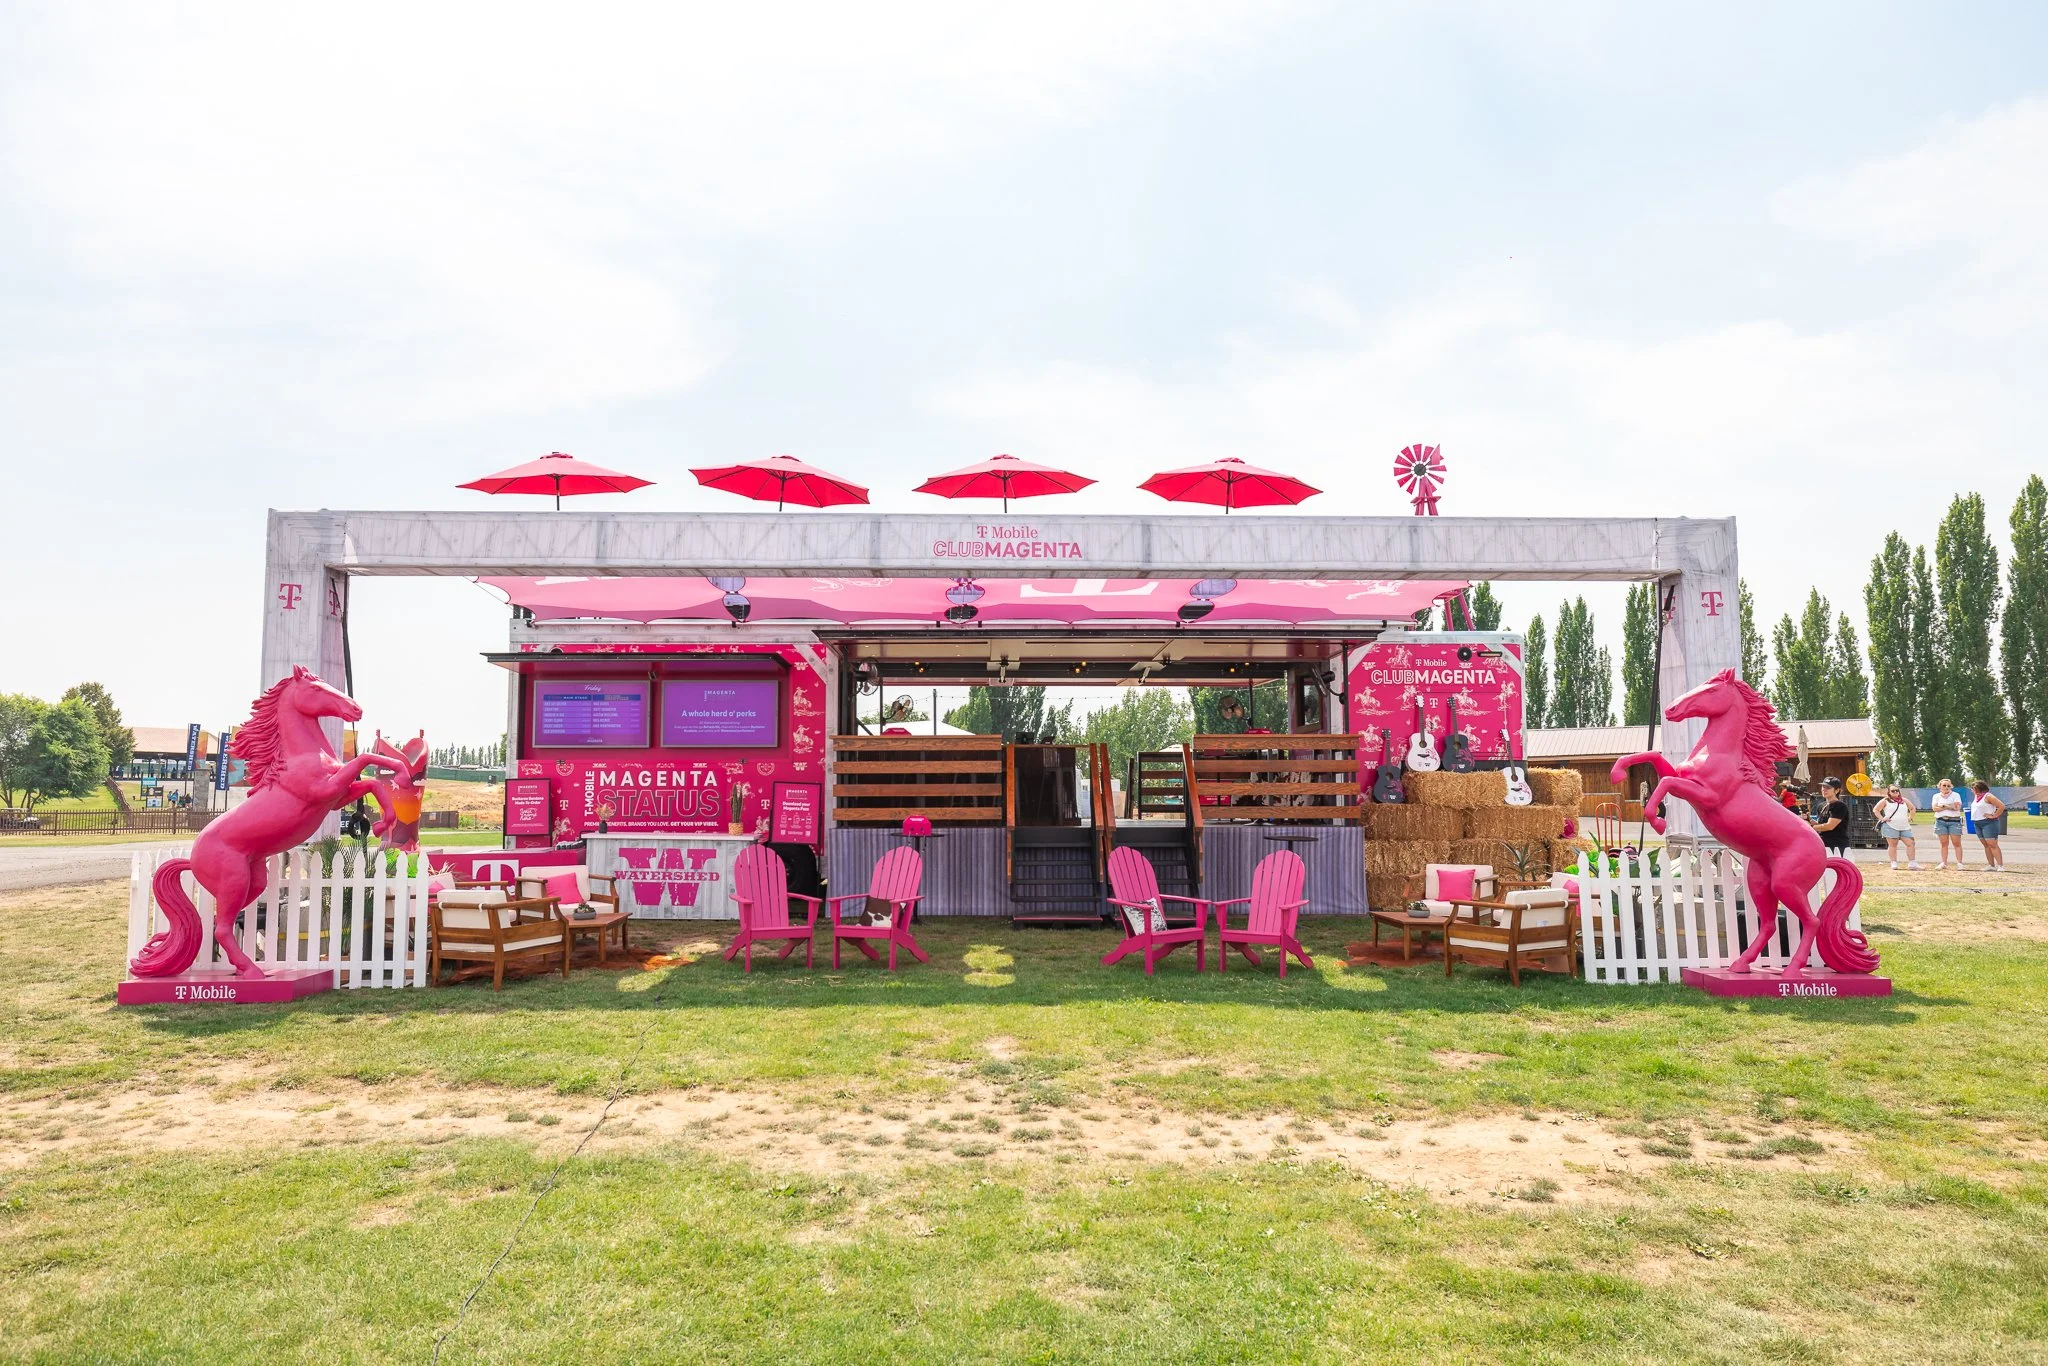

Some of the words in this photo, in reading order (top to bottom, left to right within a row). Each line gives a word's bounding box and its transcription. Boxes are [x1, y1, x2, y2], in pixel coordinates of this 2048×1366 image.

[992, 526, 1038, 539] Mobile
[933, 541, 1082, 558] CLUBMAGENTA
[278, 583, 302, 609] T
[1701, 591, 1724, 616] T
[1423, 659, 1447, 667] Mobile
[1371, 669, 1496, 684] CLUBMAGENTA
[584, 684, 602, 692] Friday
[1429, 698, 1438, 708] T
[736, 710, 756, 718] perks
[187, 725, 198, 771] WATERSHED
[600, 770, 718, 787] MAGENTA
[584, 771, 595, 816] T-MOBILE
[560, 800, 569, 810] T
[597, 789, 720, 817] STATUS
[761, 799, 770, 810] T
[614, 870, 720, 881] WATERSHED
[190, 985, 236, 999] Mobile
[1793, 983, 1837, 996] Mobile
